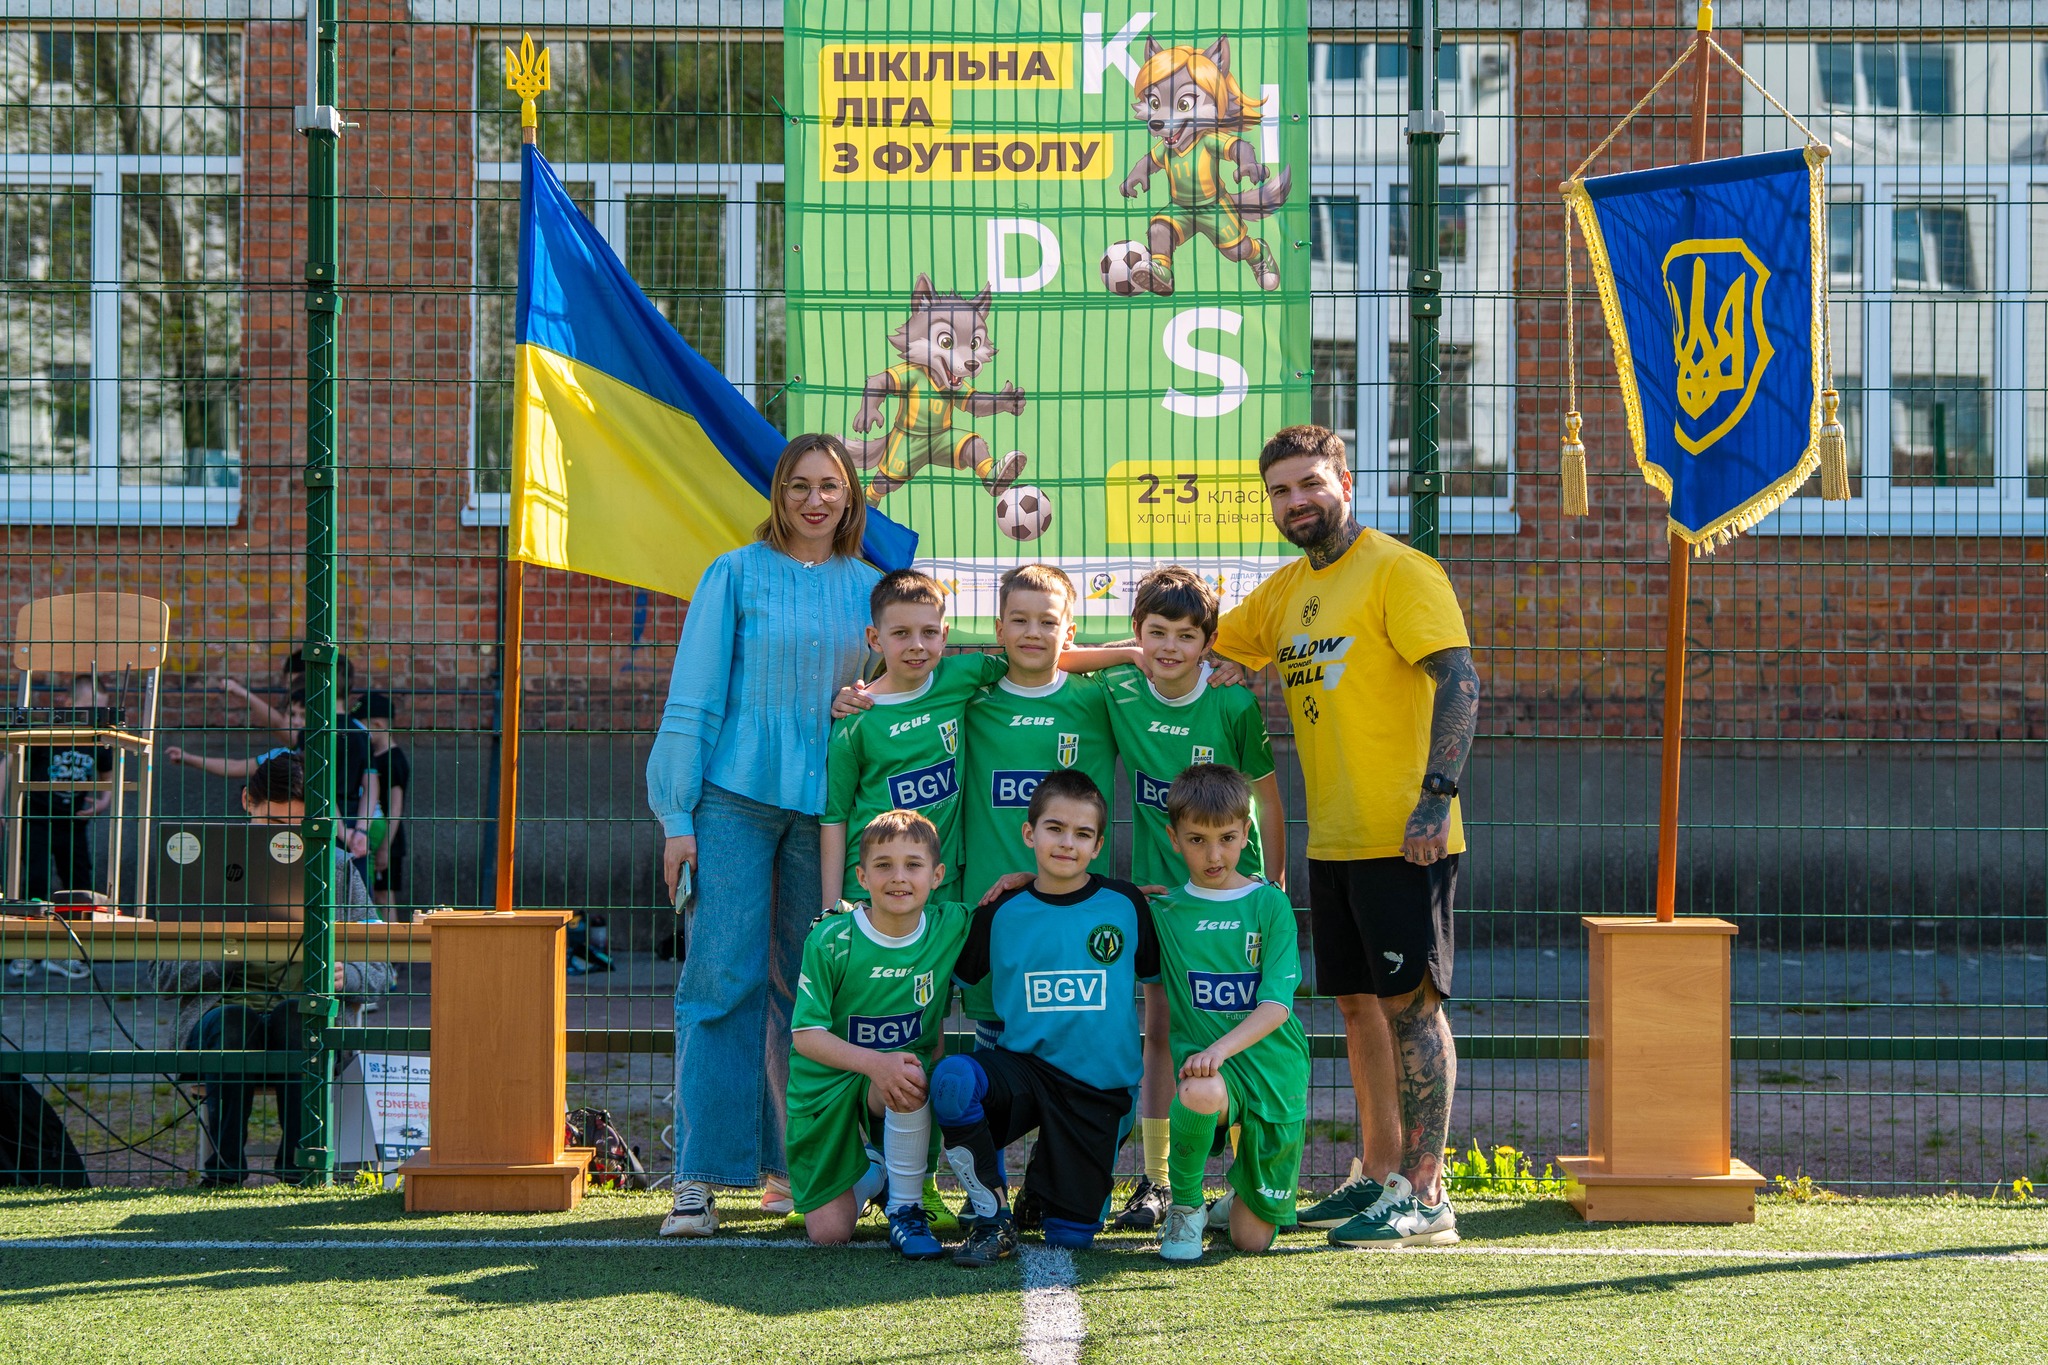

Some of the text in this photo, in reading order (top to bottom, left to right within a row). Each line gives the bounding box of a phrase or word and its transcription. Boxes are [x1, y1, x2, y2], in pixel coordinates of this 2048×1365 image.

[1083, 12, 1157, 94] K
[833, 50, 1055, 82] ШКІЛЬНА
[832, 97, 935, 128] ЛІГА
[832, 141, 1100, 175] З ФУТБОЛУ
[1174, 161, 1191, 179] 11
[1221, 224, 1236, 240] 11
[987, 219, 1061, 293] D
[1161, 307, 1249, 418] S
[893, 458, 906, 472] 10
[1137, 473, 1200, 504] 2-3
[1137, 510, 1274, 525] хлопці та дівчата
[1303, 599, 1319, 619] BVB
[1288, 659, 1312, 669] WONDER
[1284, 665, 1325, 688] WALL
[889, 713, 931, 738] Zeus
[1009, 714, 1055, 727] Zeus
[1147, 721, 1190, 736] Zeus
[896, 767, 952, 805] BGV
[1000, 778, 1045, 802] BG
[1194, 919, 1241, 932] Zeus
[869, 965, 915, 979] Zeus
[1033, 978, 1099, 1003] BGV
[1195, 980, 1256, 1006] BGV
[857, 1017, 917, 1044] BGV
[376, 1100, 430, 1110] CONFERE
[1256, 1183, 1292, 1200] Zeus
